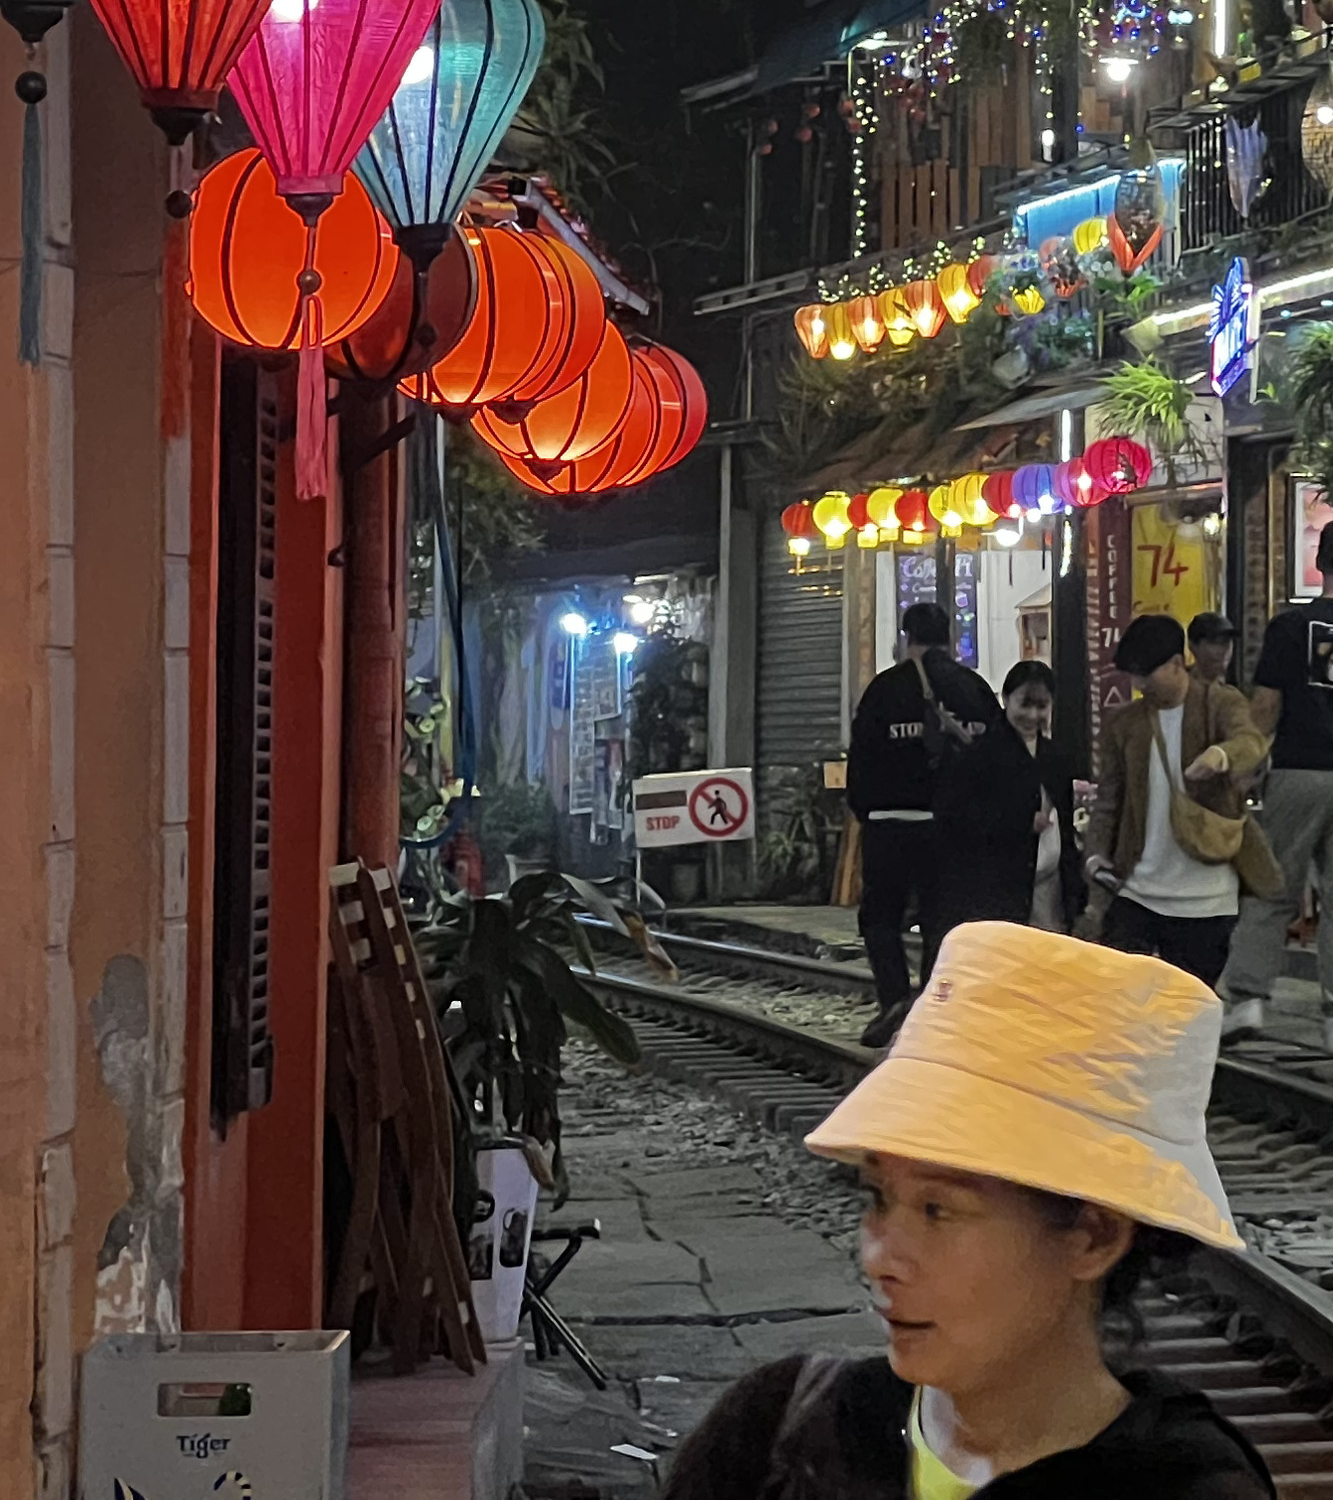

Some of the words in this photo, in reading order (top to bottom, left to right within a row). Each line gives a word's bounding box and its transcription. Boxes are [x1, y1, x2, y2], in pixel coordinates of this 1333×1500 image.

[1136, 543, 1190, 588] 74
[646, 815, 681, 832] STOP
[176, 1433, 232, 1458] Tiger
